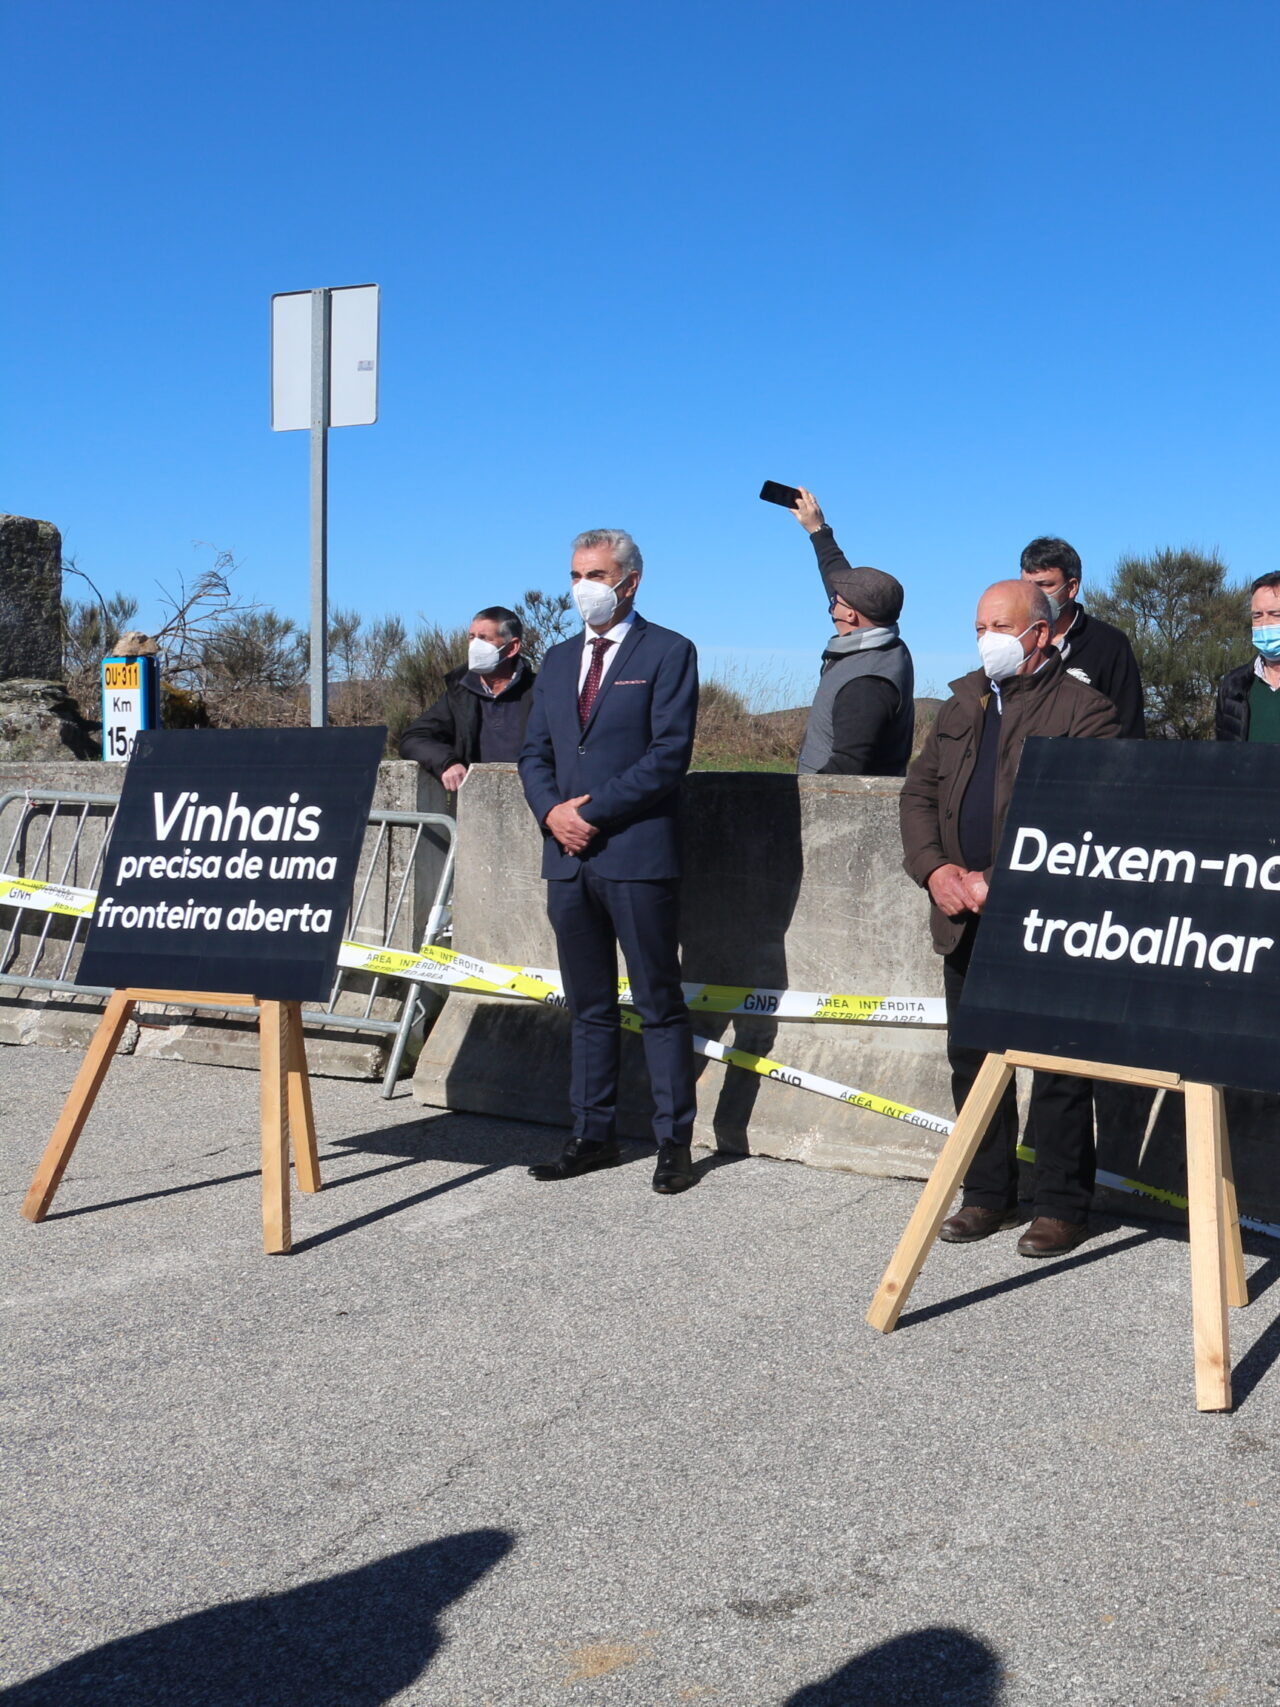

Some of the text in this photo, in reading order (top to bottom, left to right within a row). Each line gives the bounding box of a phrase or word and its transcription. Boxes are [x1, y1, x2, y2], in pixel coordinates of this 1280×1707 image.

[113, 697, 132, 712] Km
[153, 792, 323, 841] Vinhais
[116, 847, 337, 887] precisa de uma
[97, 897, 333, 933] fronteira aberta
[1022, 908, 1274, 973] trabalhar
[440, 951, 485, 974] INTERDITA
[743, 994, 778, 1013] GNR
[816, 995, 925, 1012] ÁREA INTERDITA
